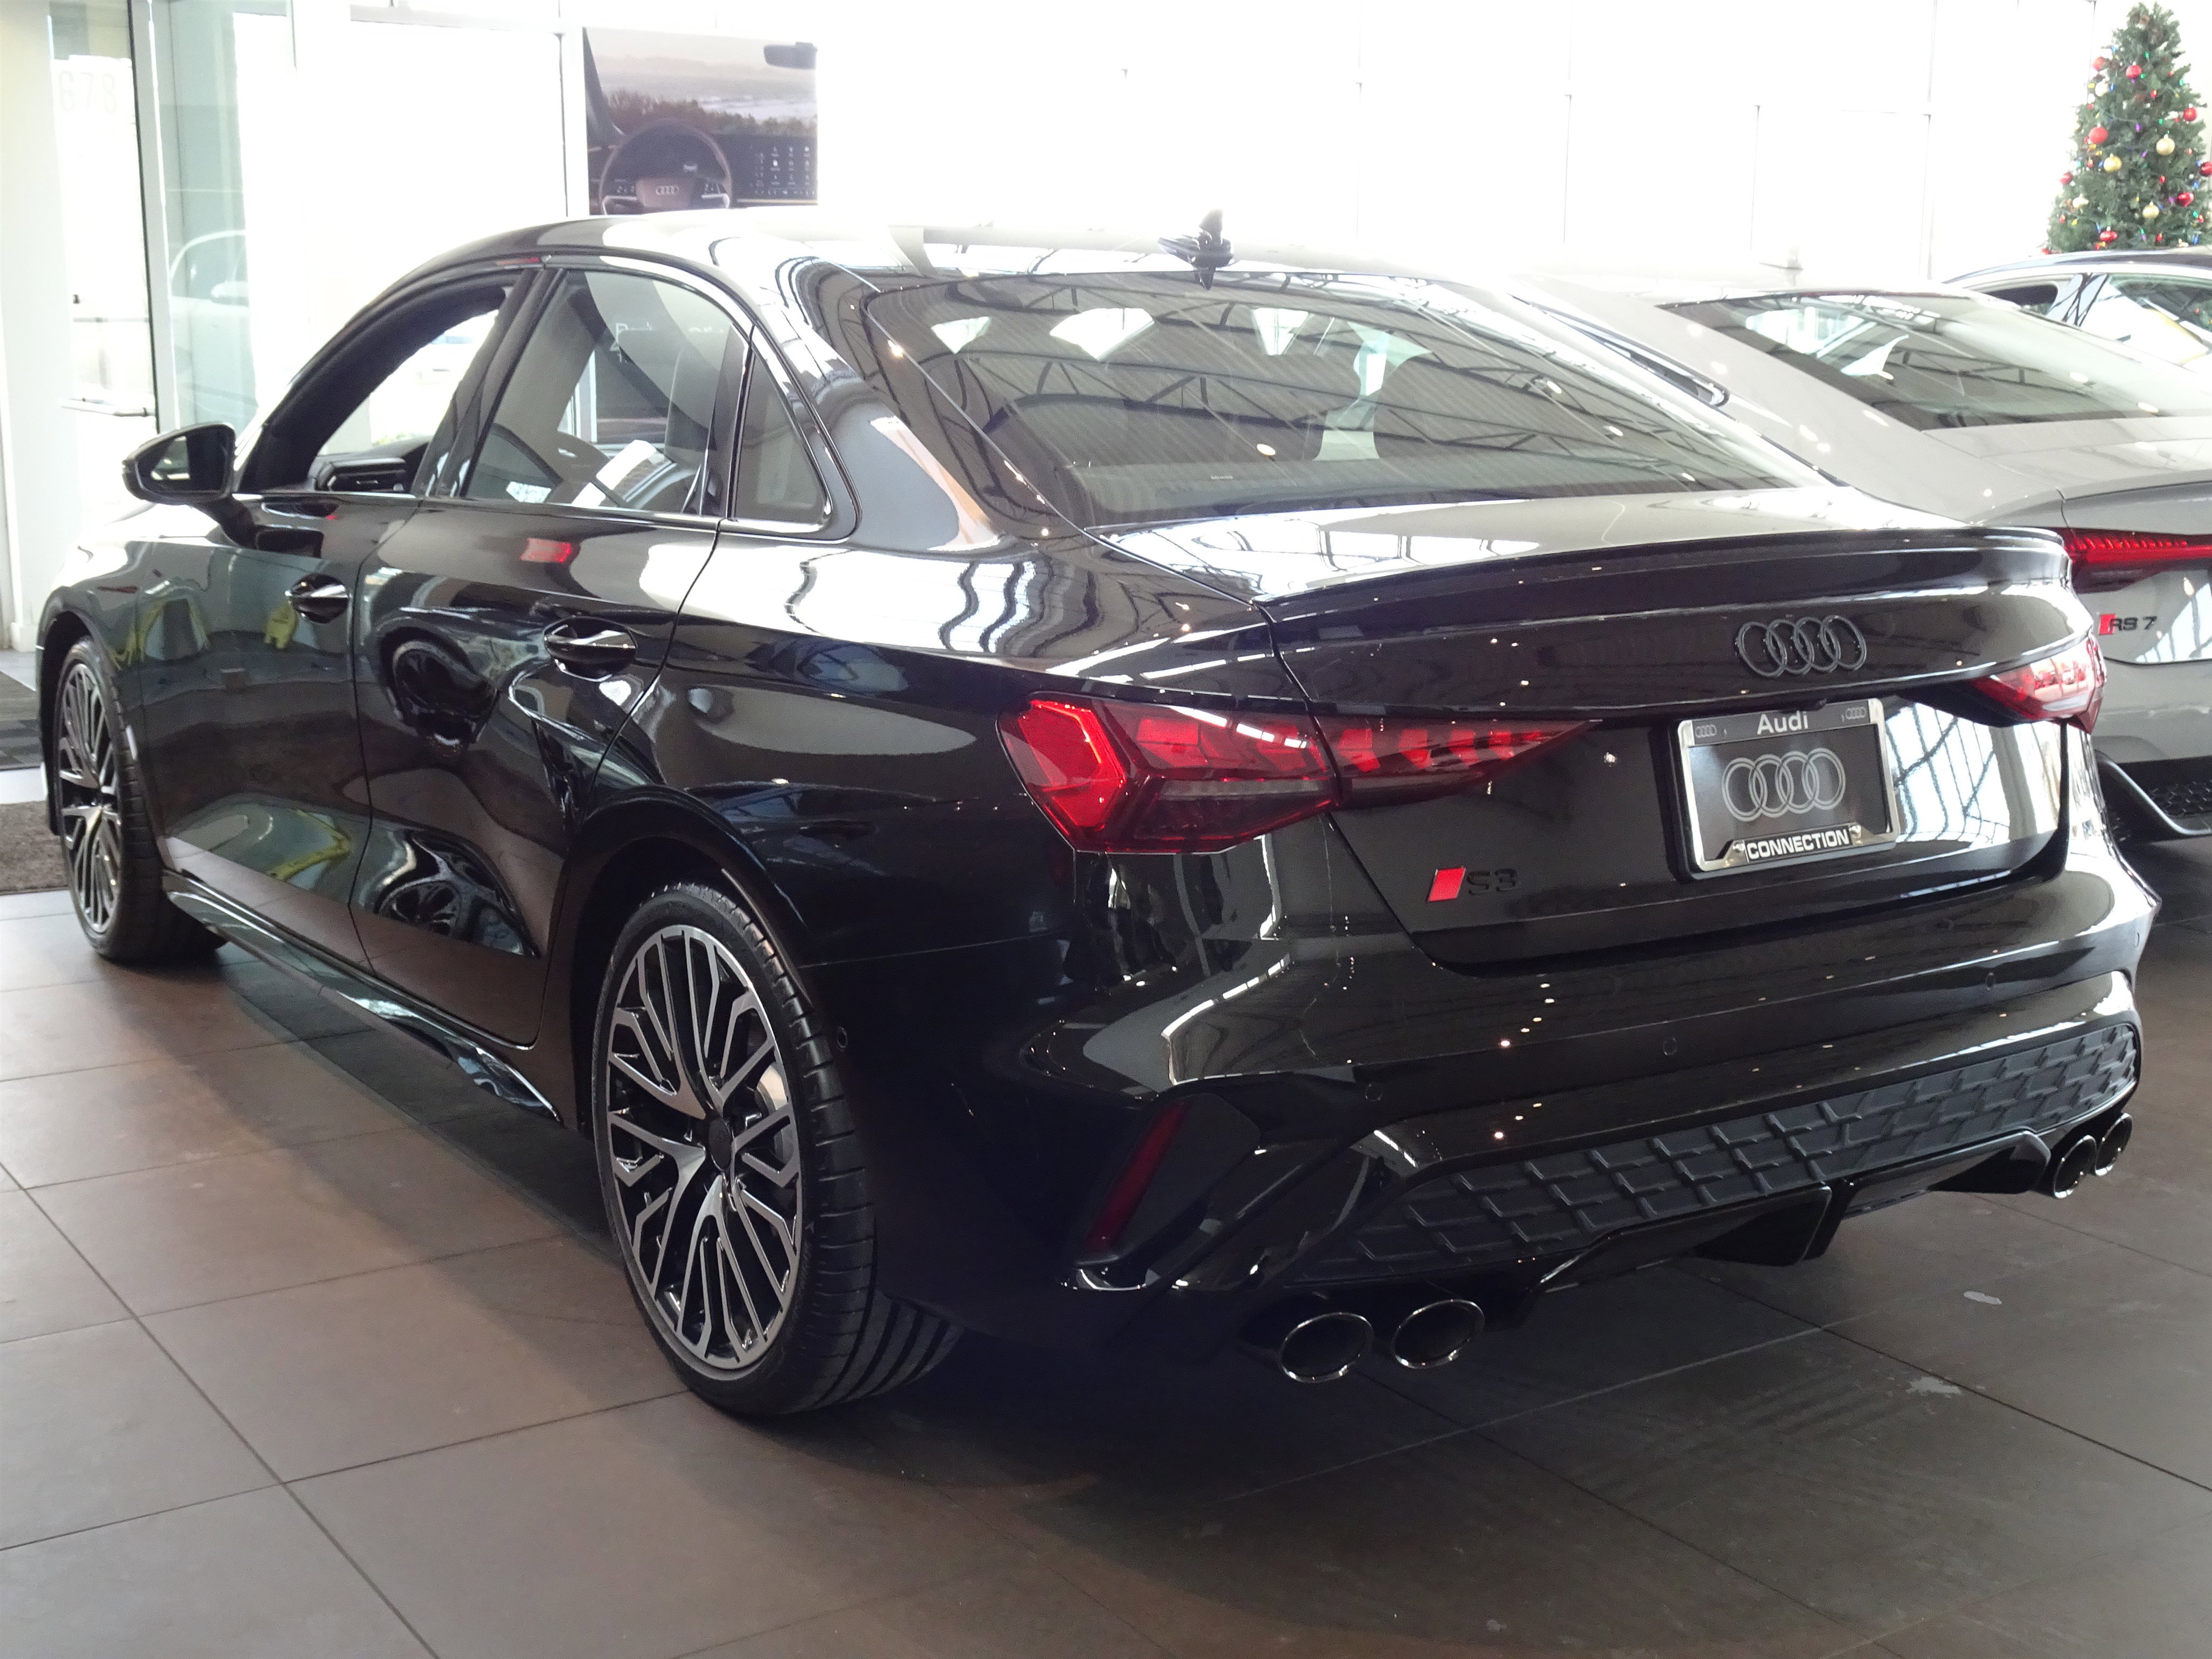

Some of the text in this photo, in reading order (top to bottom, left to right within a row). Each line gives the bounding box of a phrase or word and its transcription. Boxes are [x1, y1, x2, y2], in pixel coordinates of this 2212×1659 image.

[58, 71, 116, 112] 678
[2109, 616, 2158, 631] RS 7
[1757, 711, 1809, 735] Audi
[1747, 829, 1850, 860] CONNECTION
[1467, 868, 1518, 895] S3
